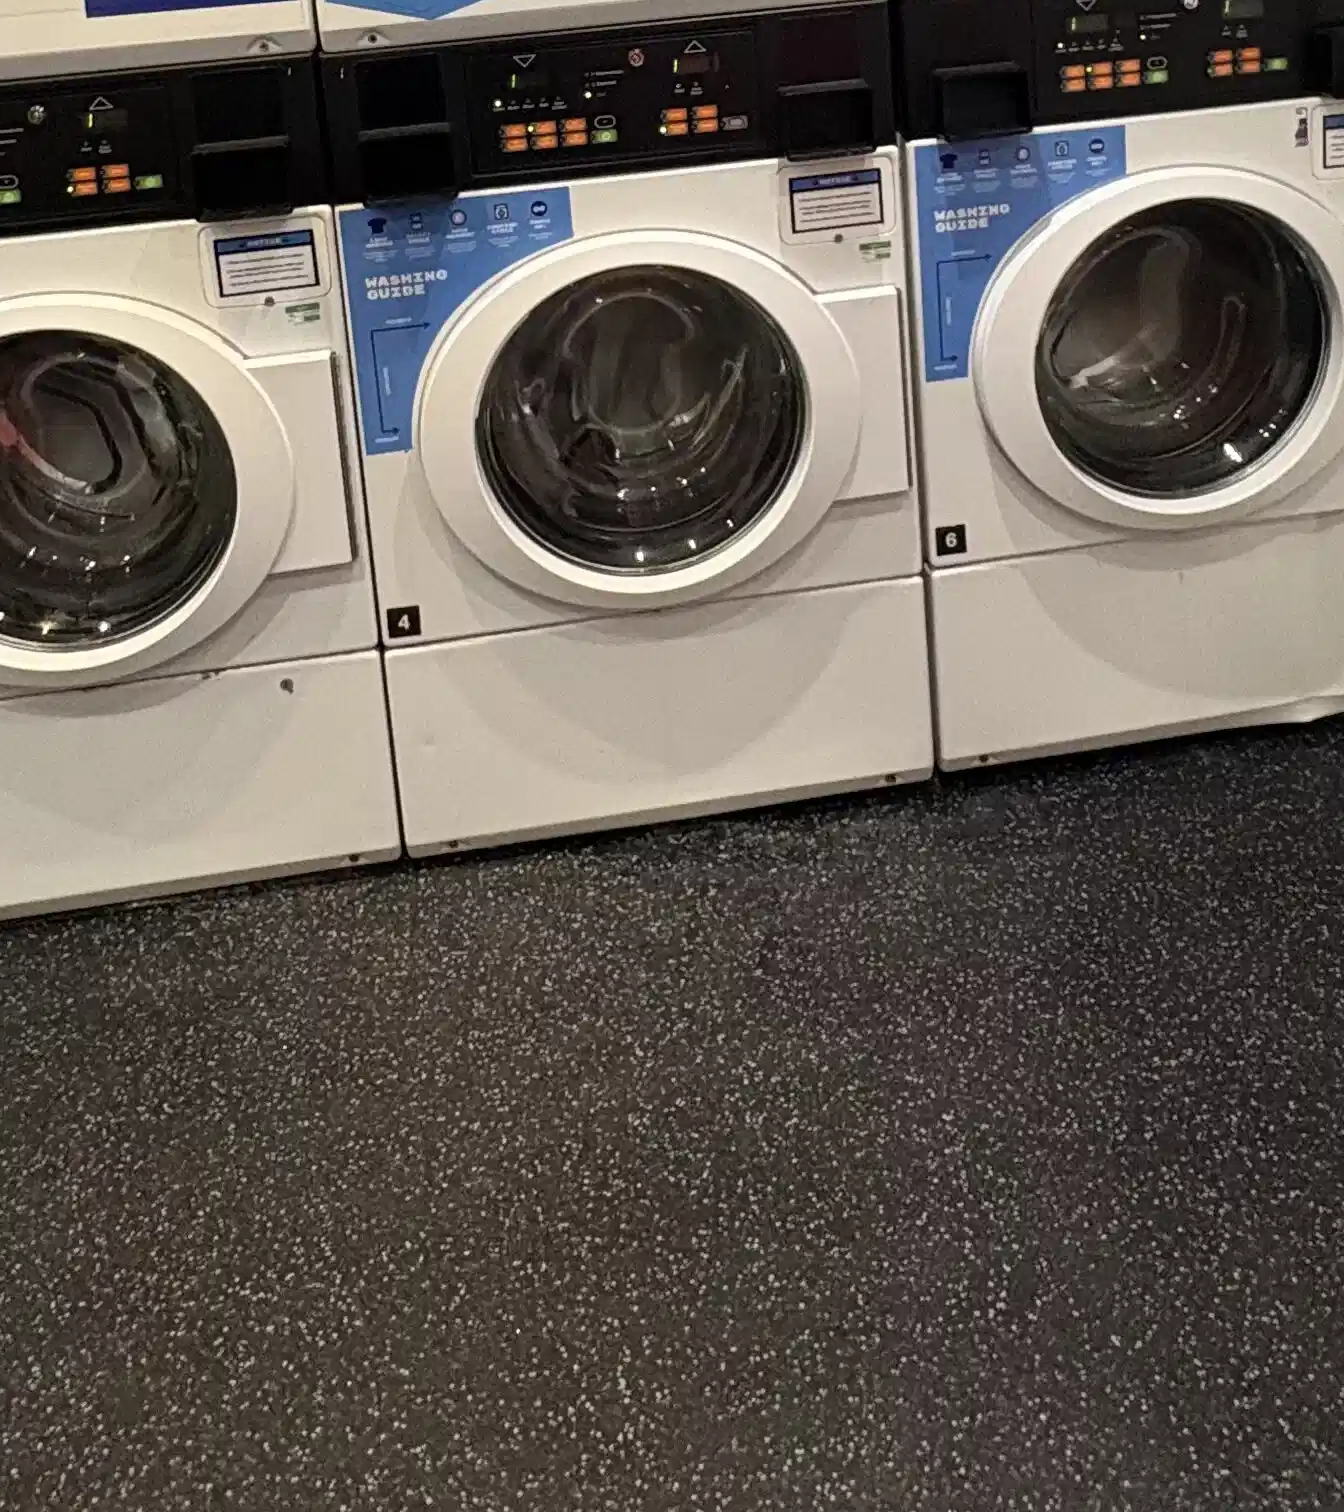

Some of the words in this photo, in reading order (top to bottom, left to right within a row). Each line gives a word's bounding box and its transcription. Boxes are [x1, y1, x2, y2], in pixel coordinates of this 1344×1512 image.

[933, 203, 1011, 221] WASHING
[935, 216, 989, 233] GUIDE
[364, 269, 448, 288] WASHING
[367, 284, 425, 301] GUIDE
[946, 532, 957, 548] 6
[398, 614, 410, 630] 4
